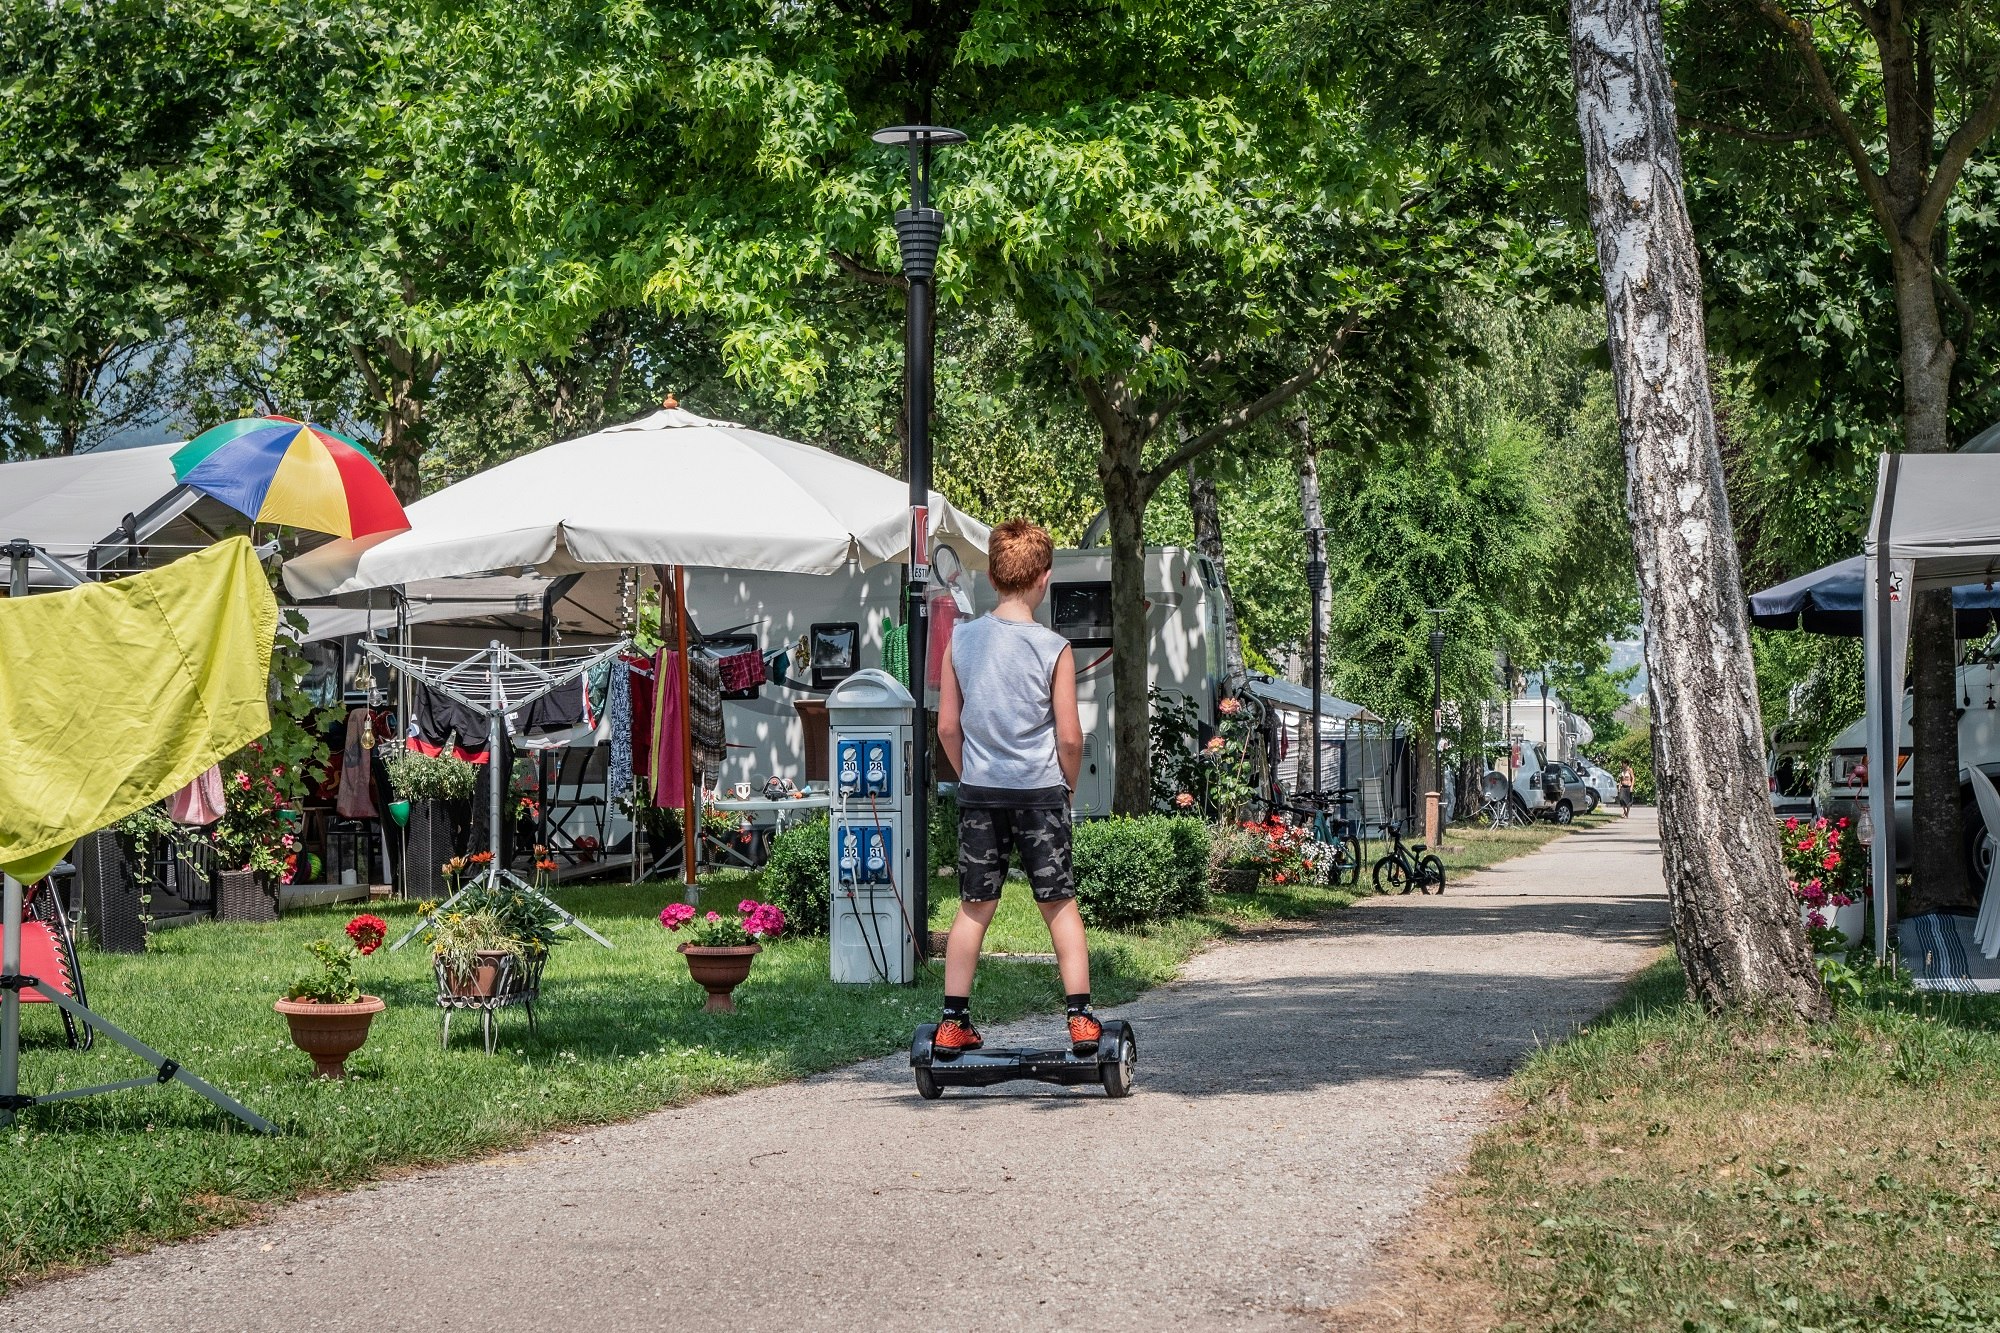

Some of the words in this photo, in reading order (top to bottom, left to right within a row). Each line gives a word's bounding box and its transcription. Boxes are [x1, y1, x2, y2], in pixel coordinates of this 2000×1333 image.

[844, 762, 856, 771] 30
[870, 762, 882, 771] 28
[844, 848, 856, 858] 32
[871, 848, 882, 858] 31
